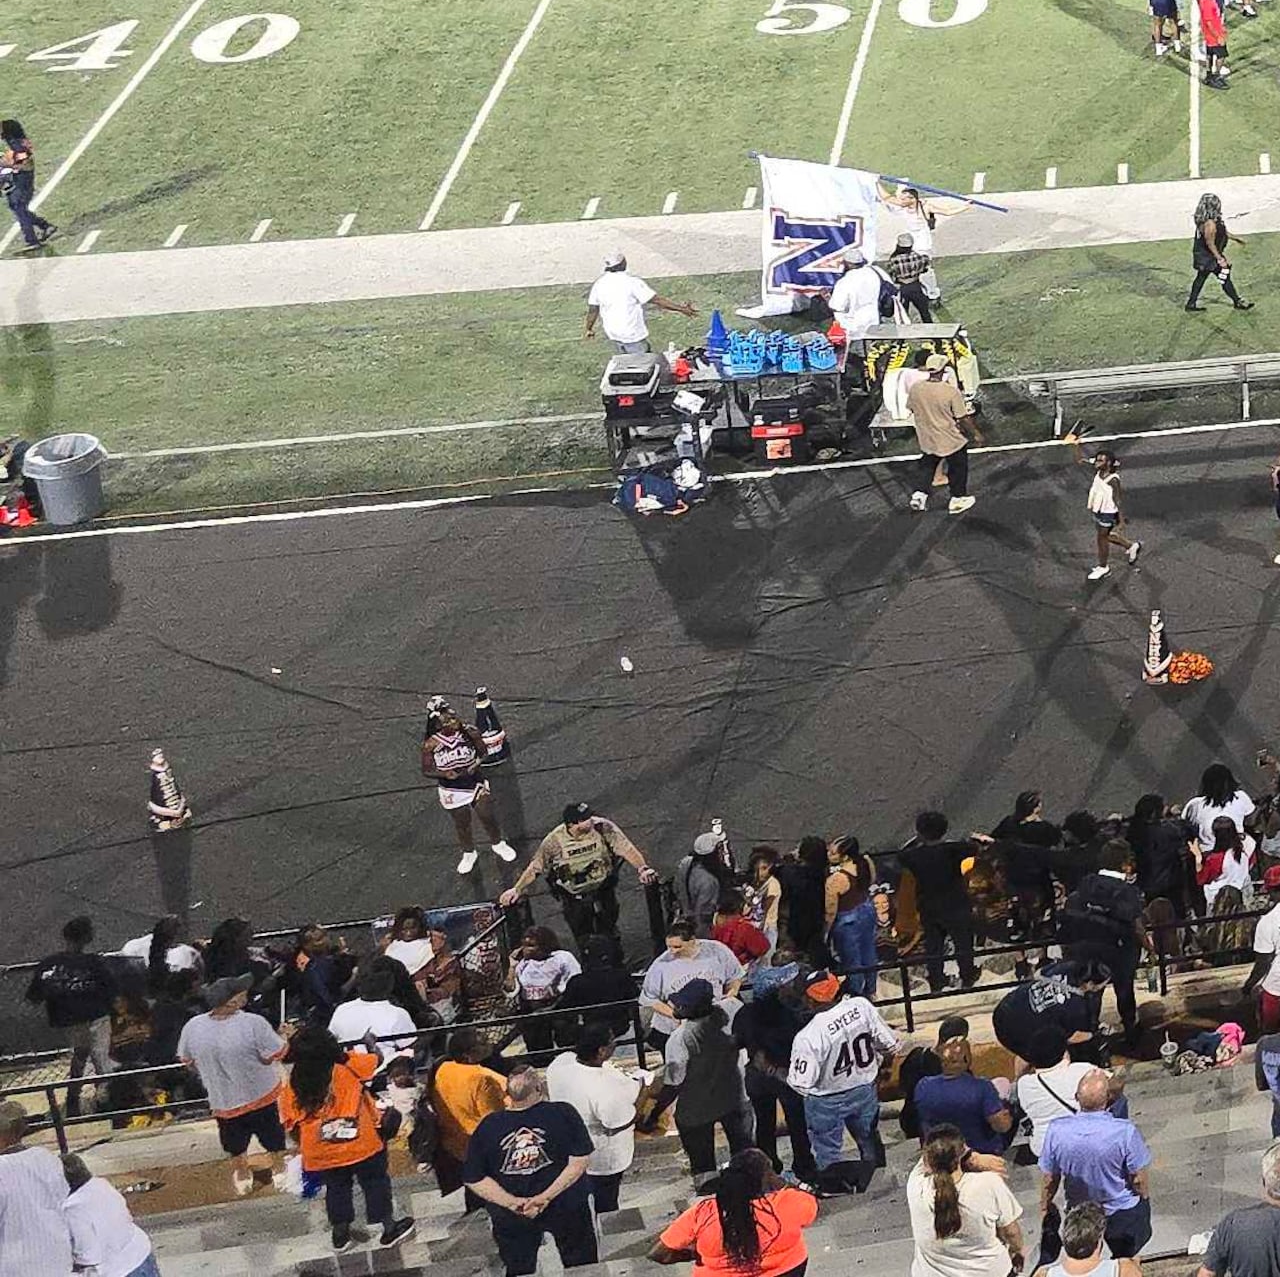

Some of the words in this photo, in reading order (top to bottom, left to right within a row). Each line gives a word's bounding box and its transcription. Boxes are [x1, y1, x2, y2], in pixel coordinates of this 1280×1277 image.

[27, 13, 301, 71] 40
[768, 207, 864, 296] N
[833, 1032, 875, 1078] 40
